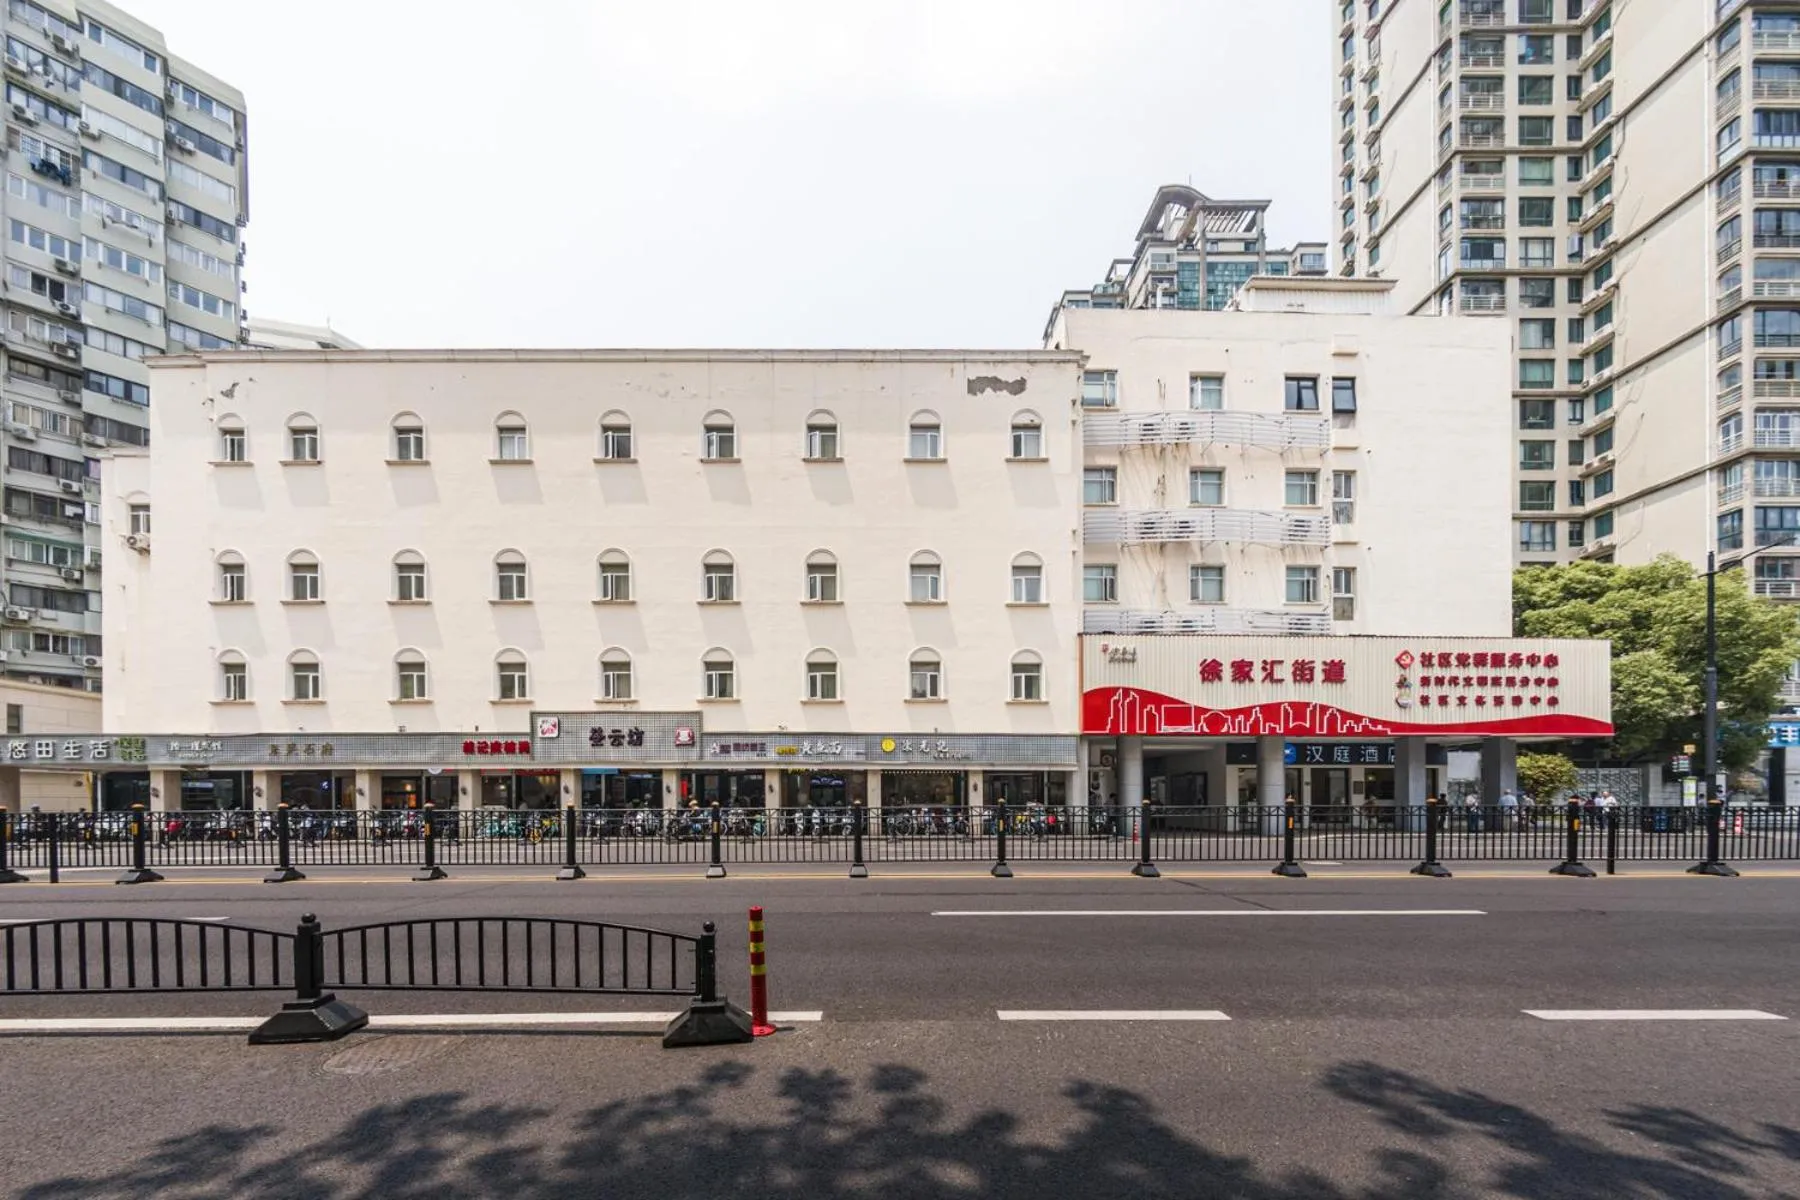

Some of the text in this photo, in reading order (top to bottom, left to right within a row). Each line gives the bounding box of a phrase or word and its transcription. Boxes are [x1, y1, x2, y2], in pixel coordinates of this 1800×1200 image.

[1420, 652, 1559, 668] 社区党群服务中心
[1199, 658, 1346, 683] 徐家汇街道
[8, 739, 110, 759] 悠田生活
